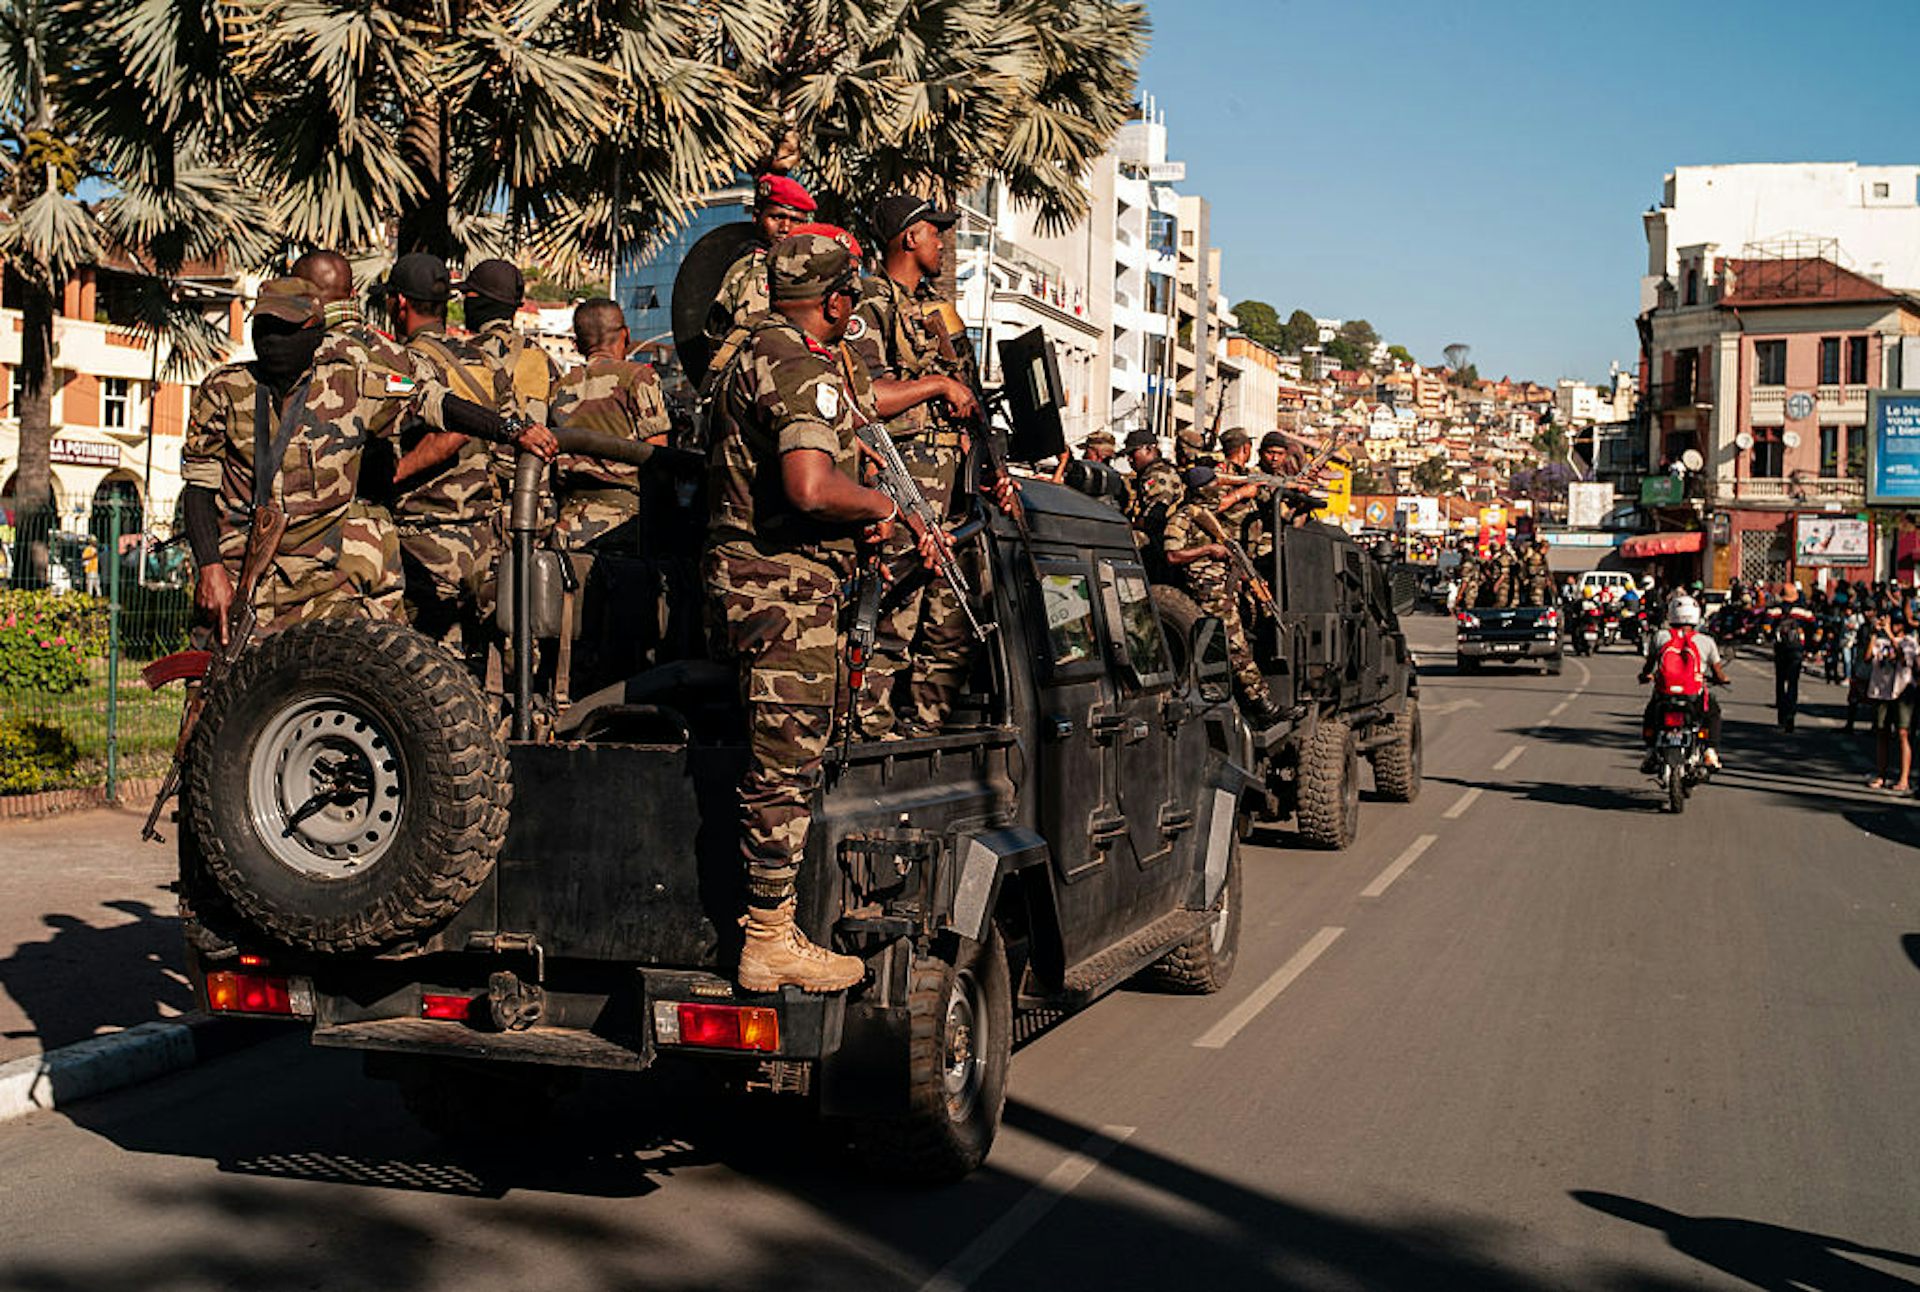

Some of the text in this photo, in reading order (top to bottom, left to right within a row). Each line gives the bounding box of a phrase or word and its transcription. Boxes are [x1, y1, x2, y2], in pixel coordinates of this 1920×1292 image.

[1151, 165, 1182, 174] HOTEL
[1886, 405, 1901, 416] Le
[1887, 417, 1914, 426] vous
[50, 439, 65, 454] LA
